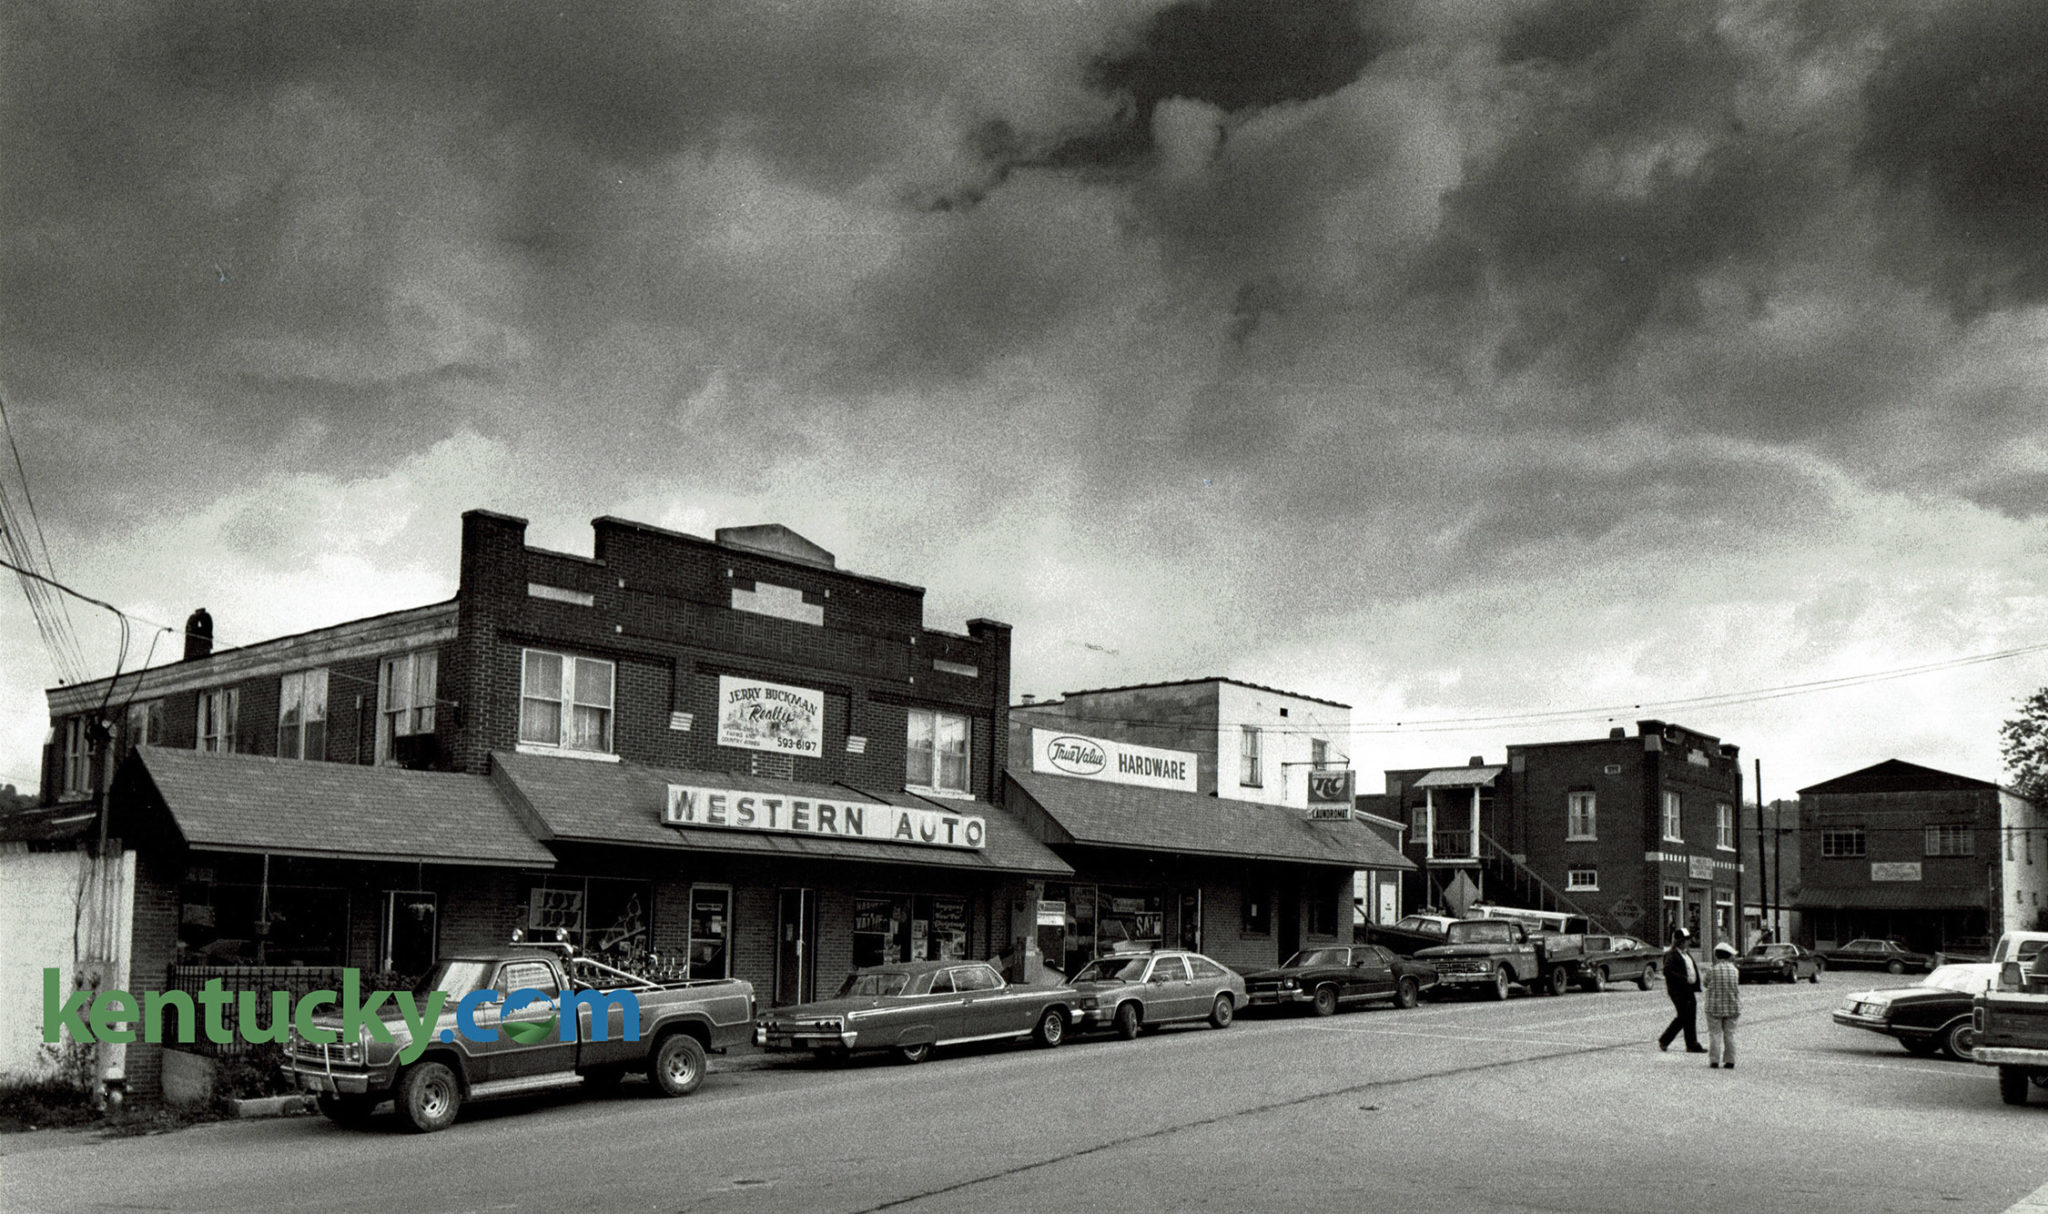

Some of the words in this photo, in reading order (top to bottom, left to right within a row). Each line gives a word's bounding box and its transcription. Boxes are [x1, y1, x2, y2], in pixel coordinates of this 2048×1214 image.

[728, 688, 761, 704] JERRY
[765, 688, 818, 716] BUCKMAN
[748, 703, 794, 727] Realty
[777, 737, 817, 751] 593-6197
[1118, 753, 1186, 780] HARDWARE
[674, 791, 864, 836] WESTERN
[895, 812, 983, 847] AUTO
[1136, 915, 1160, 937] SAL
